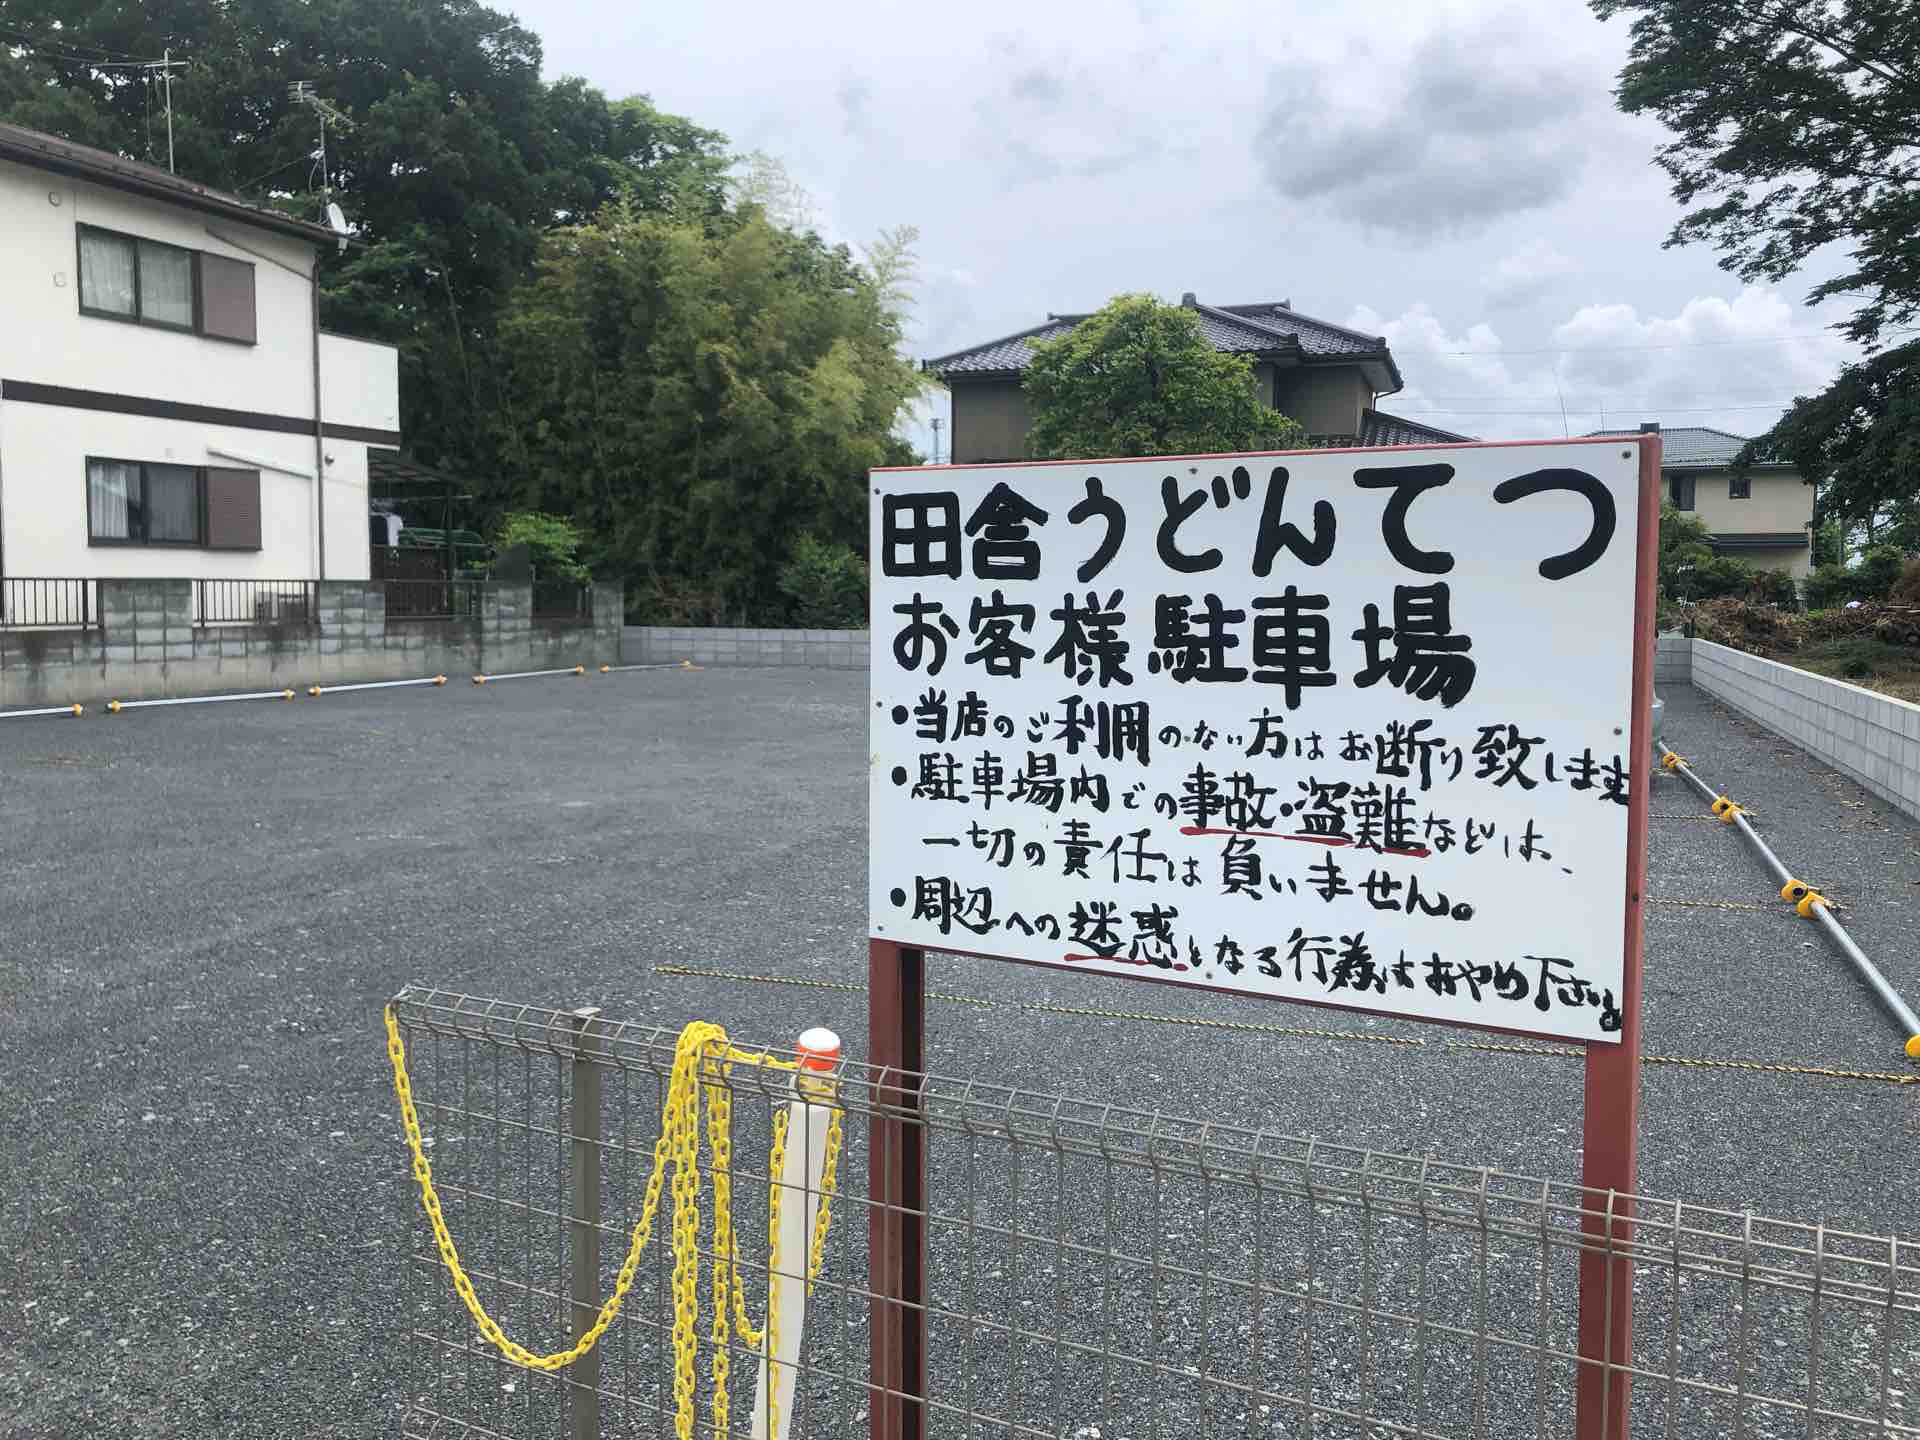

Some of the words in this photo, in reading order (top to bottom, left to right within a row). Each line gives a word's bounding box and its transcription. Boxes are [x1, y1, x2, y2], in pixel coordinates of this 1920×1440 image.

[882, 463, 1616, 583] 田舎うどんてつ
[892, 583, 1477, 709] お客様駐車場
[922, 818, 1474, 921] 一切の責任は負いません。
